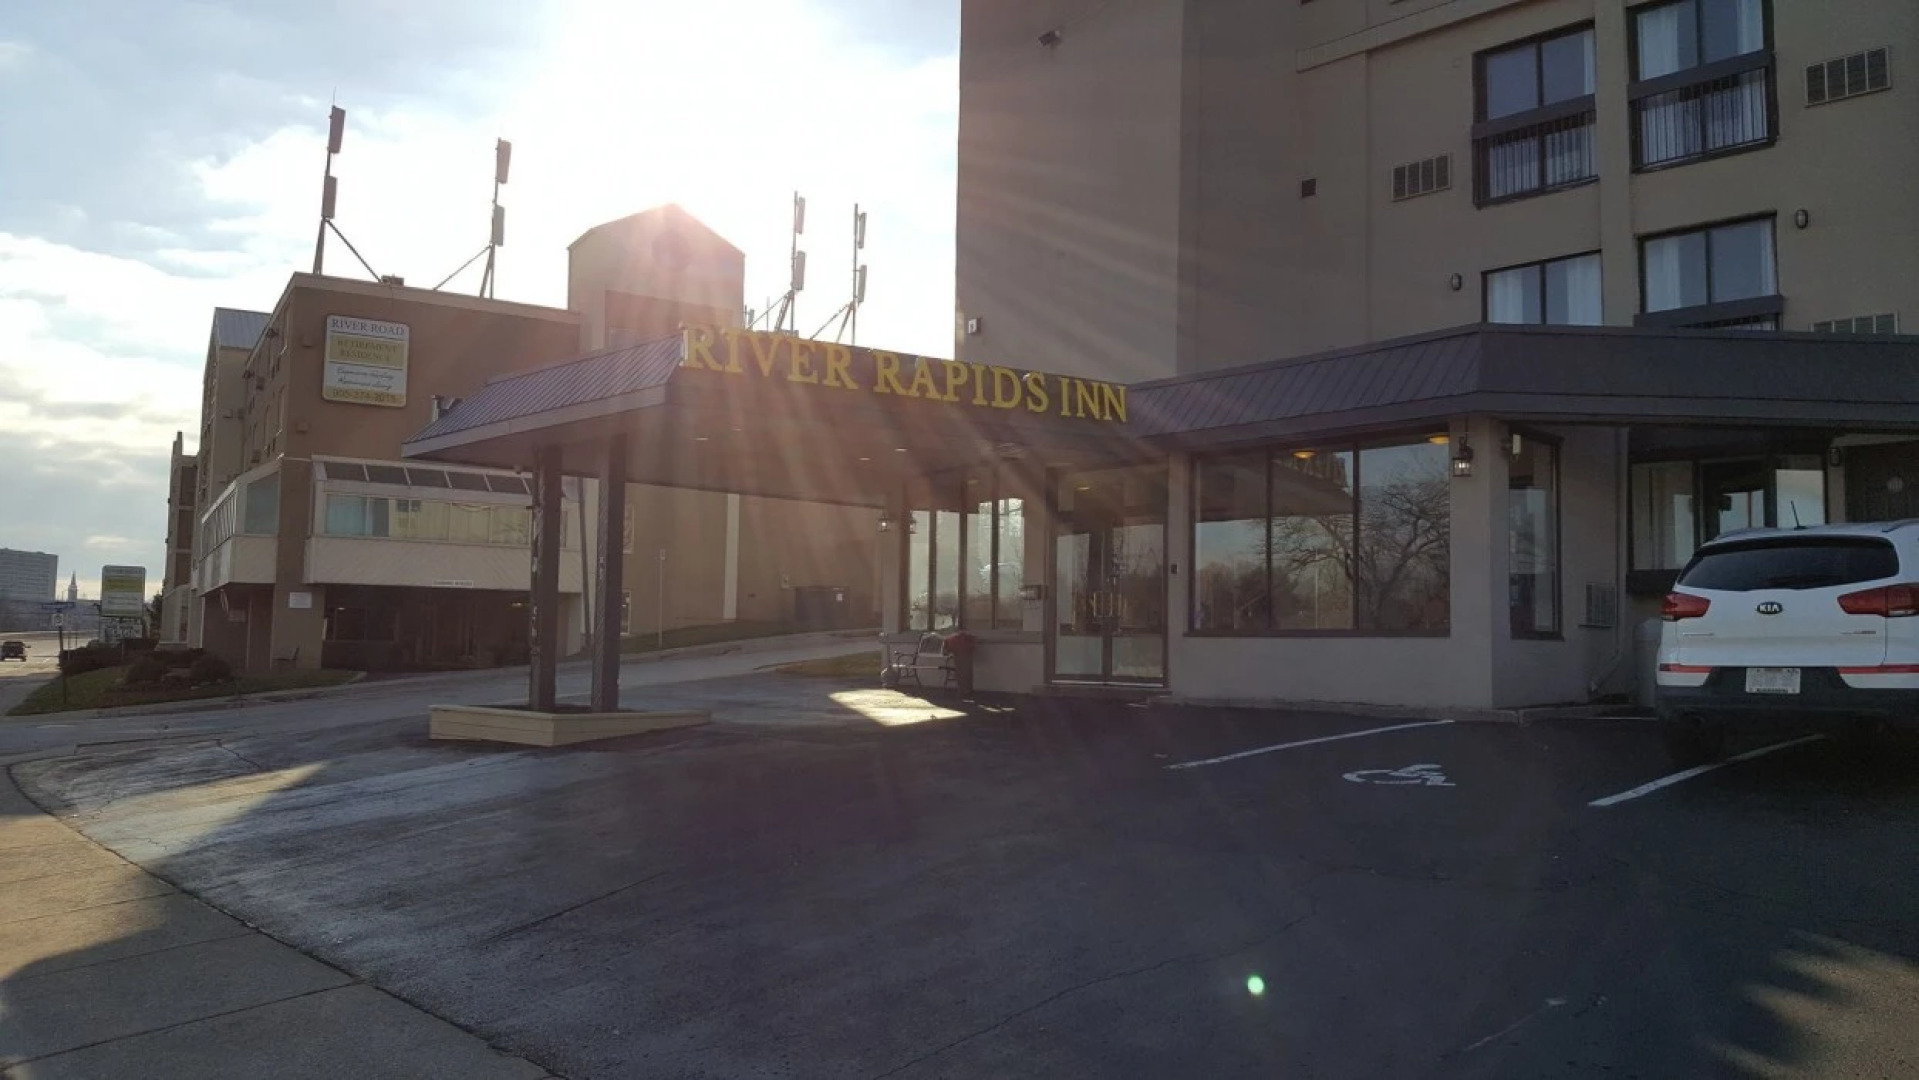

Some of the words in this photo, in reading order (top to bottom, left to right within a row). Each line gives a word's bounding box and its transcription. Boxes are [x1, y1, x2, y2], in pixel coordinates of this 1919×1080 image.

[332, 319, 368, 332] RIVER
[371, 323, 405, 336] ROAD
[679, 324, 859, 390] RIVER
[872, 350, 1049, 413] RAPIDS
[1060, 376, 1127, 423] INN
[1759, 604, 1780, 612] KIA
